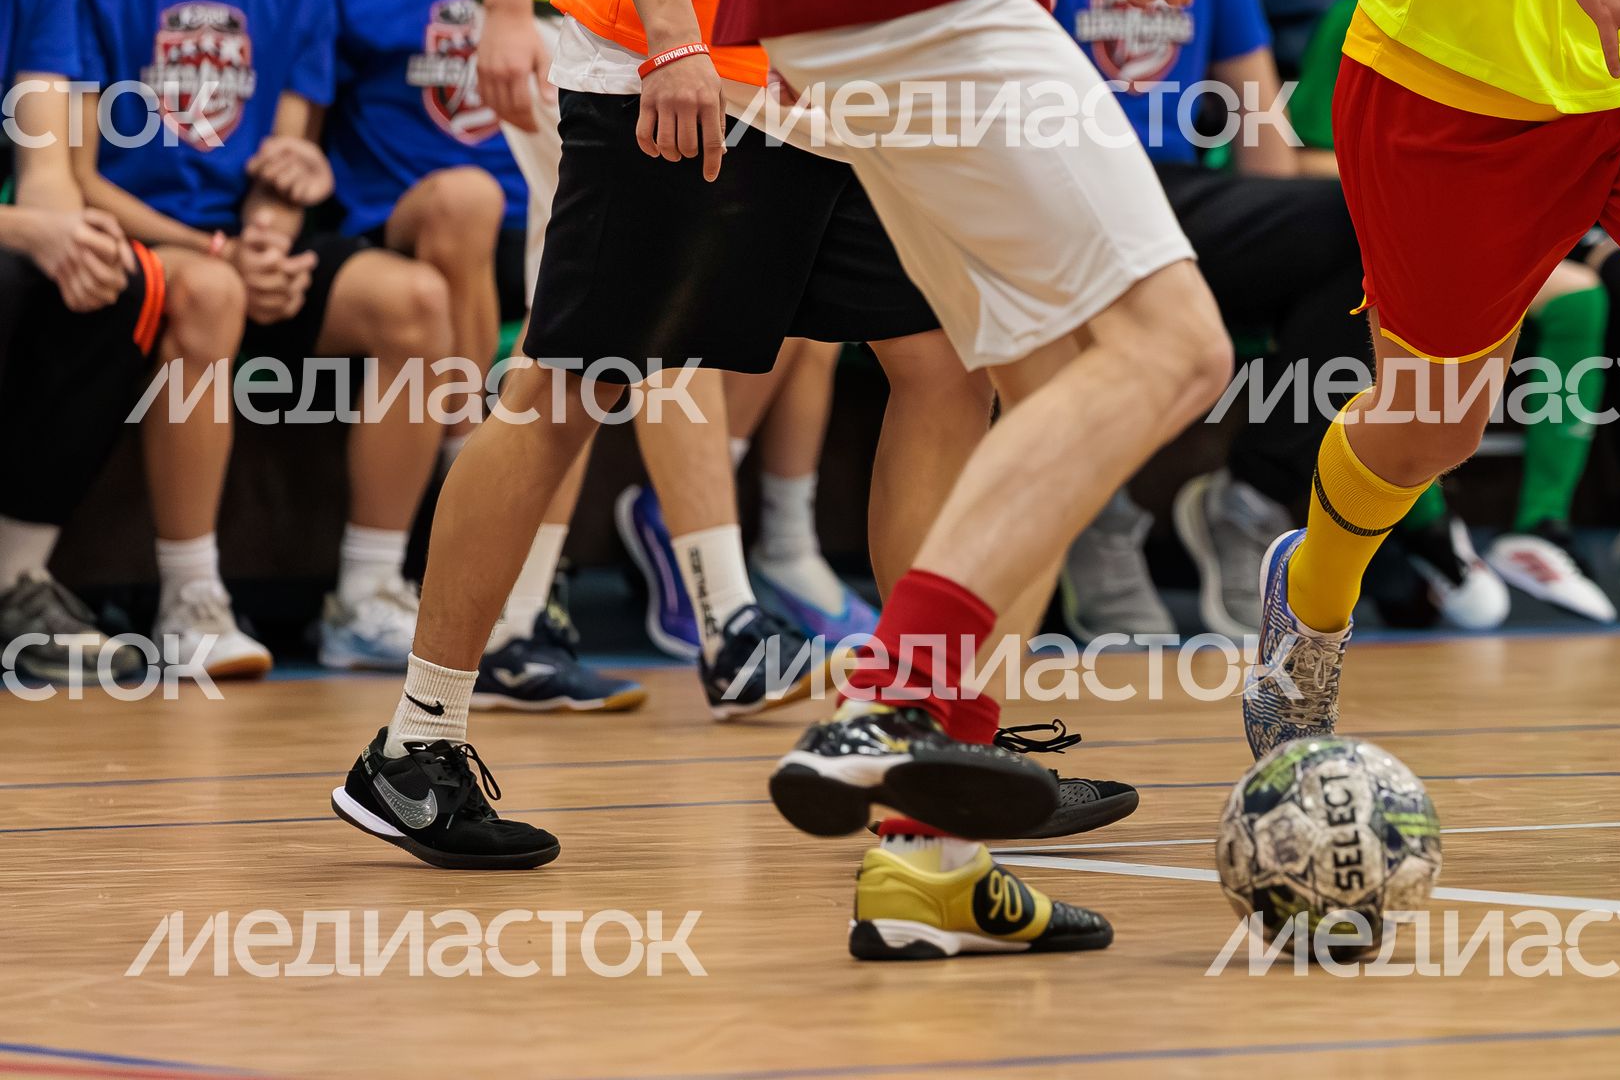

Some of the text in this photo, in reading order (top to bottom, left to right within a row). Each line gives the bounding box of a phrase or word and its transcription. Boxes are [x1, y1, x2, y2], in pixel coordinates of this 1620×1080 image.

[687, 45, 695, 53] В
[1319, 774, 1365, 892] SELECT
[988, 869, 1023, 923] 90
